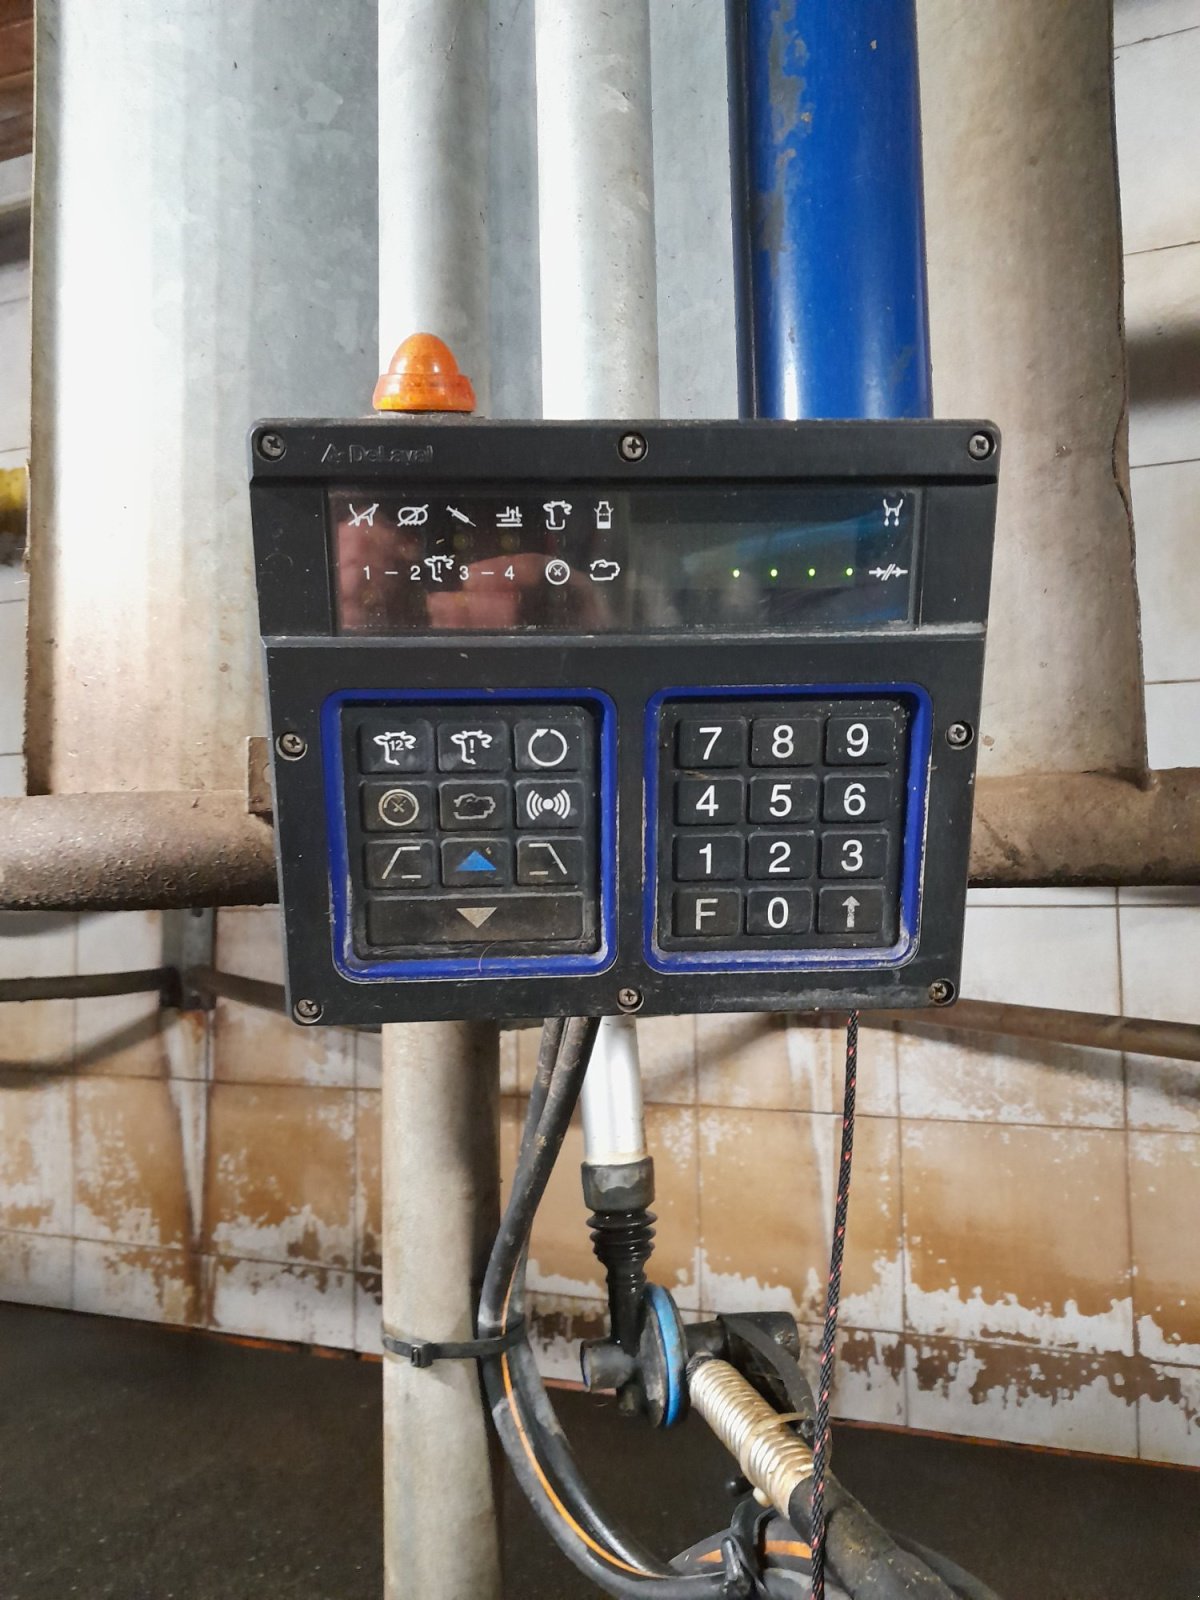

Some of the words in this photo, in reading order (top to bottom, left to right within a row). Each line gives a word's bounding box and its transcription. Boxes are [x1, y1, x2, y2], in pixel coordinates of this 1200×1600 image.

[348, 443, 434, 466] DeLaval
[363, 565, 370, 580] 1
[410, 565, 421, 581] 2
[459, 565, 470, 581] 3
[504, 565, 515, 581] 4
[388, 739, 405, 751] 12
[699, 726, 723, 761] 7
[771, 724, 795, 759] 8
[846, 722, 869, 758] 9
[695, 784, 720, 817] 4
[769, 783, 792, 817] 5
[843, 782, 866, 816] 6
[698, 842, 712, 875] 1
[768, 841, 791, 873] 2
[840, 839, 864, 872] 3
[695, 898, 719, 931] F
[767, 896, 789, 929] 0
